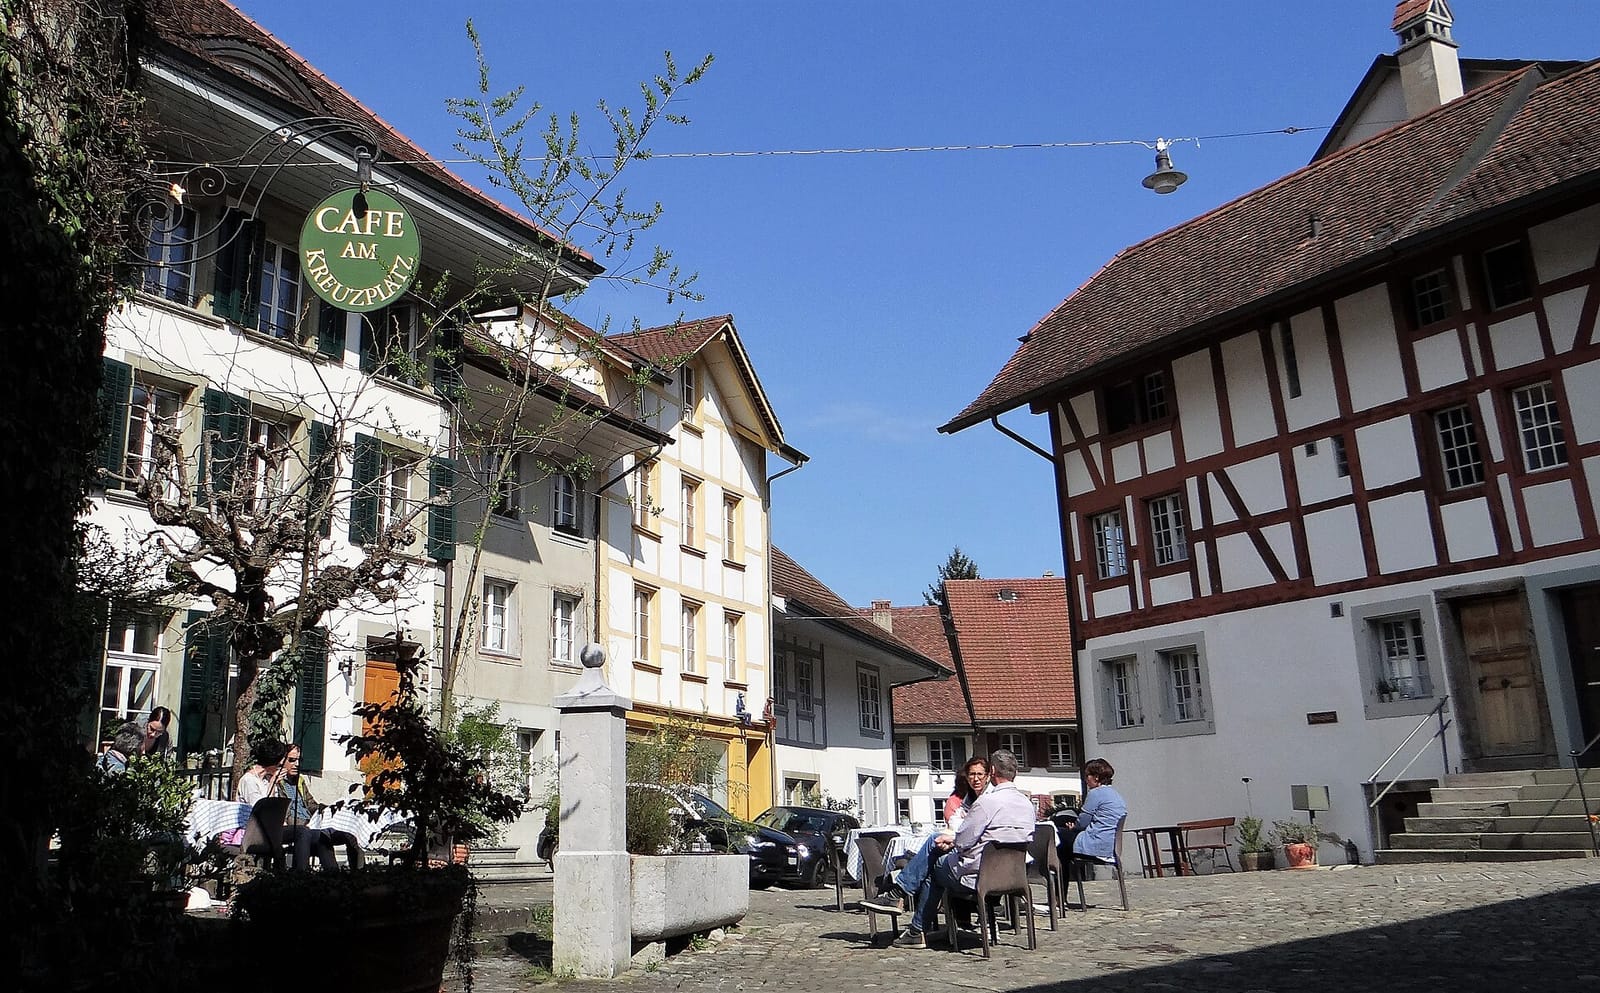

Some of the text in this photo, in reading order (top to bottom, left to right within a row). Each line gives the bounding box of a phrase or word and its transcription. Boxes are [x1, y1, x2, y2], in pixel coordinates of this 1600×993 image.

[315, 207, 404, 237] CAFE
[340, 241, 378, 260] AM
[306, 248, 414, 306] KREUZPLATZ
